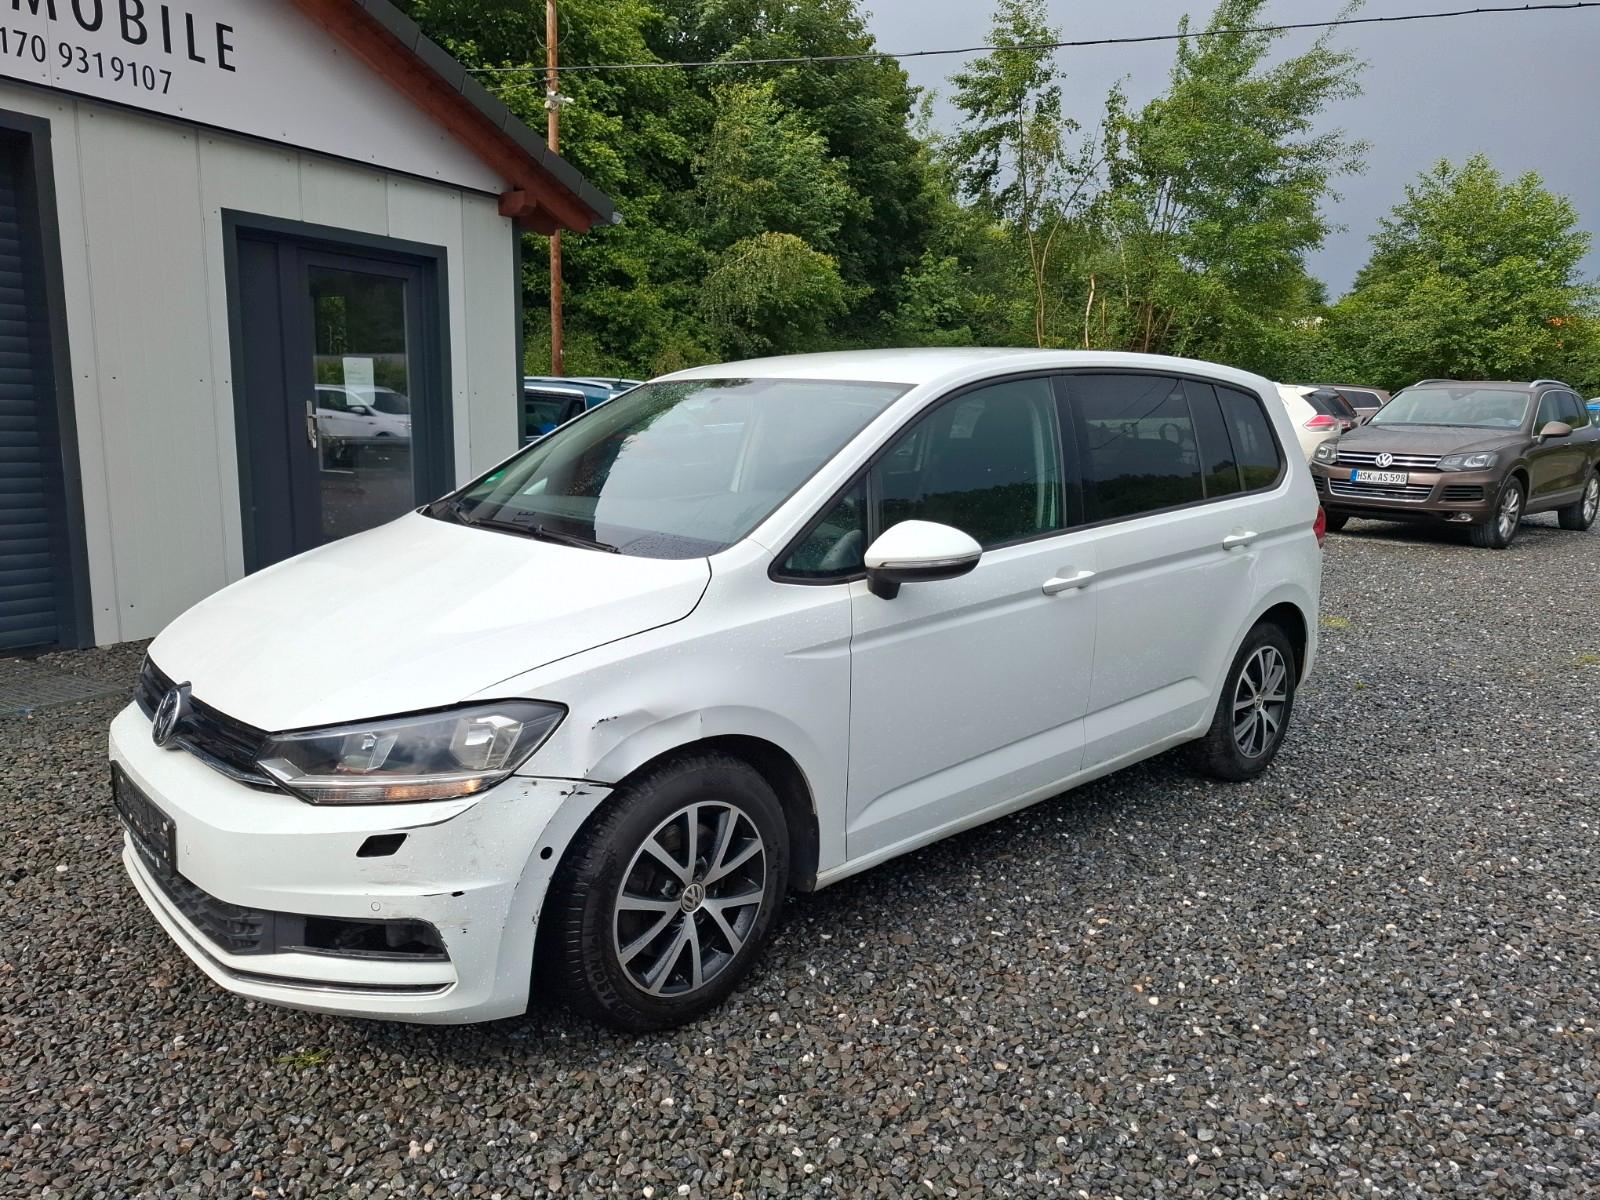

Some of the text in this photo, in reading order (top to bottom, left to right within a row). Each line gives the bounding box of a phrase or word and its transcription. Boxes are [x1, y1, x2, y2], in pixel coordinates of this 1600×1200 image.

[58, 42, 172, 95] 9319107
[1357, 471, 1373, 481] HSK
[1377, 473, 1389, 482] AS
